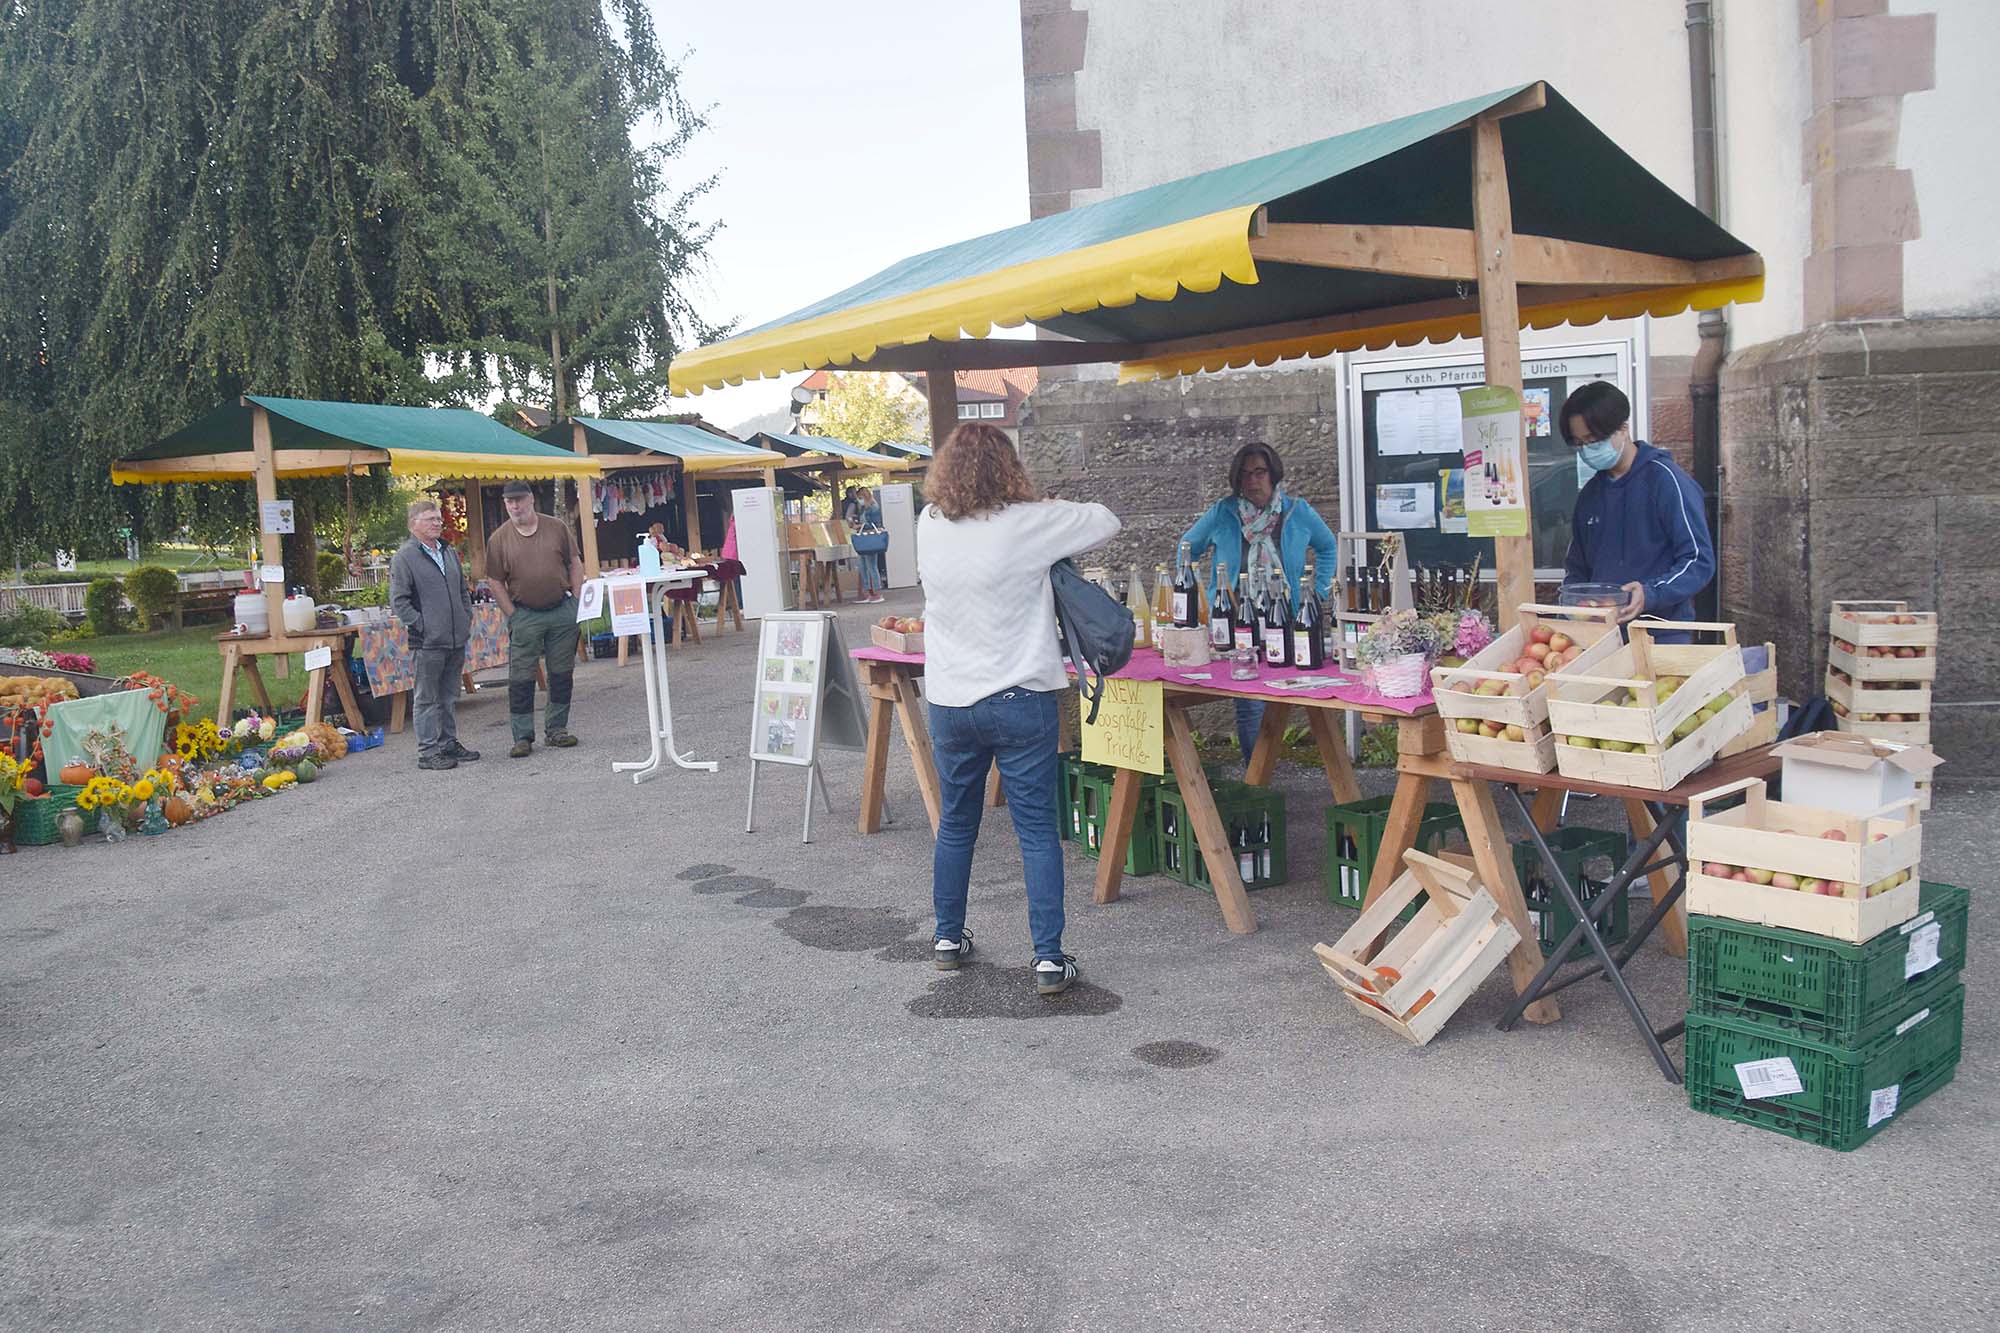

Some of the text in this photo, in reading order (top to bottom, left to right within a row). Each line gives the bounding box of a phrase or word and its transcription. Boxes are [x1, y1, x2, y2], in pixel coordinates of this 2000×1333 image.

[1405, 373, 1436, 384] Kath.
[1531, 362, 1568, 375] Ulrich
[1088, 705, 1154, 739] oospfaff-
[1104, 731, 1150, 764] Prickler
